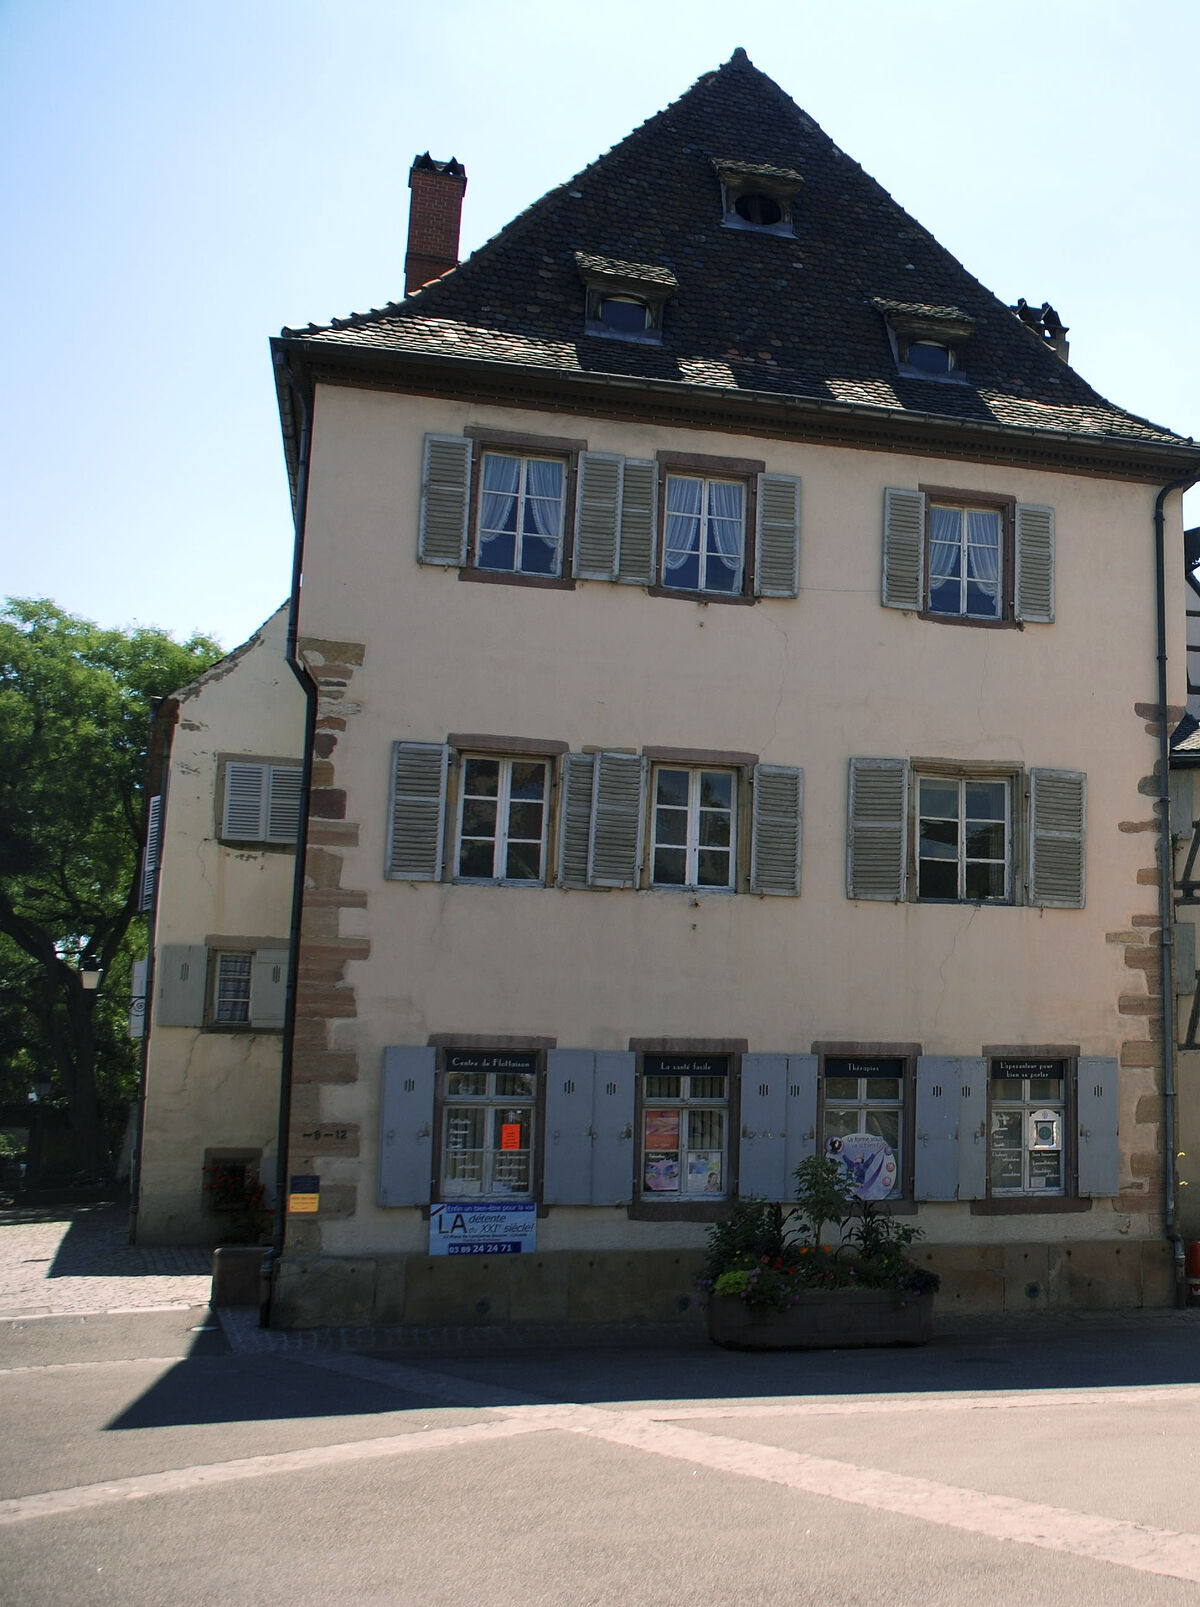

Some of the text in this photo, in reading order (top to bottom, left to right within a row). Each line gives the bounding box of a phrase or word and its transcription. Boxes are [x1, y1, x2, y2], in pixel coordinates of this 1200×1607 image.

[451, 1056, 478, 1067] Centre
[481, 1057, 490, 1067] de
[660, 1061, 670, 1070] La
[692, 1062, 711, 1071] facile
[1039, 1063, 1053, 1071] pour
[1006, 1070, 1019, 1078] bien
[1030, 1071, 1049, 1079] porter
[502, 1204, 516, 1212] pour
[469, 1214, 506, 1223] détente
[439, 1214, 467, 1234] LA
[449, 1245, 459, 1254] 03
[472, 1244, 484, 1253] 24
[486, 1243, 498, 1253] 24
[500, 1243, 512, 1252] 71
